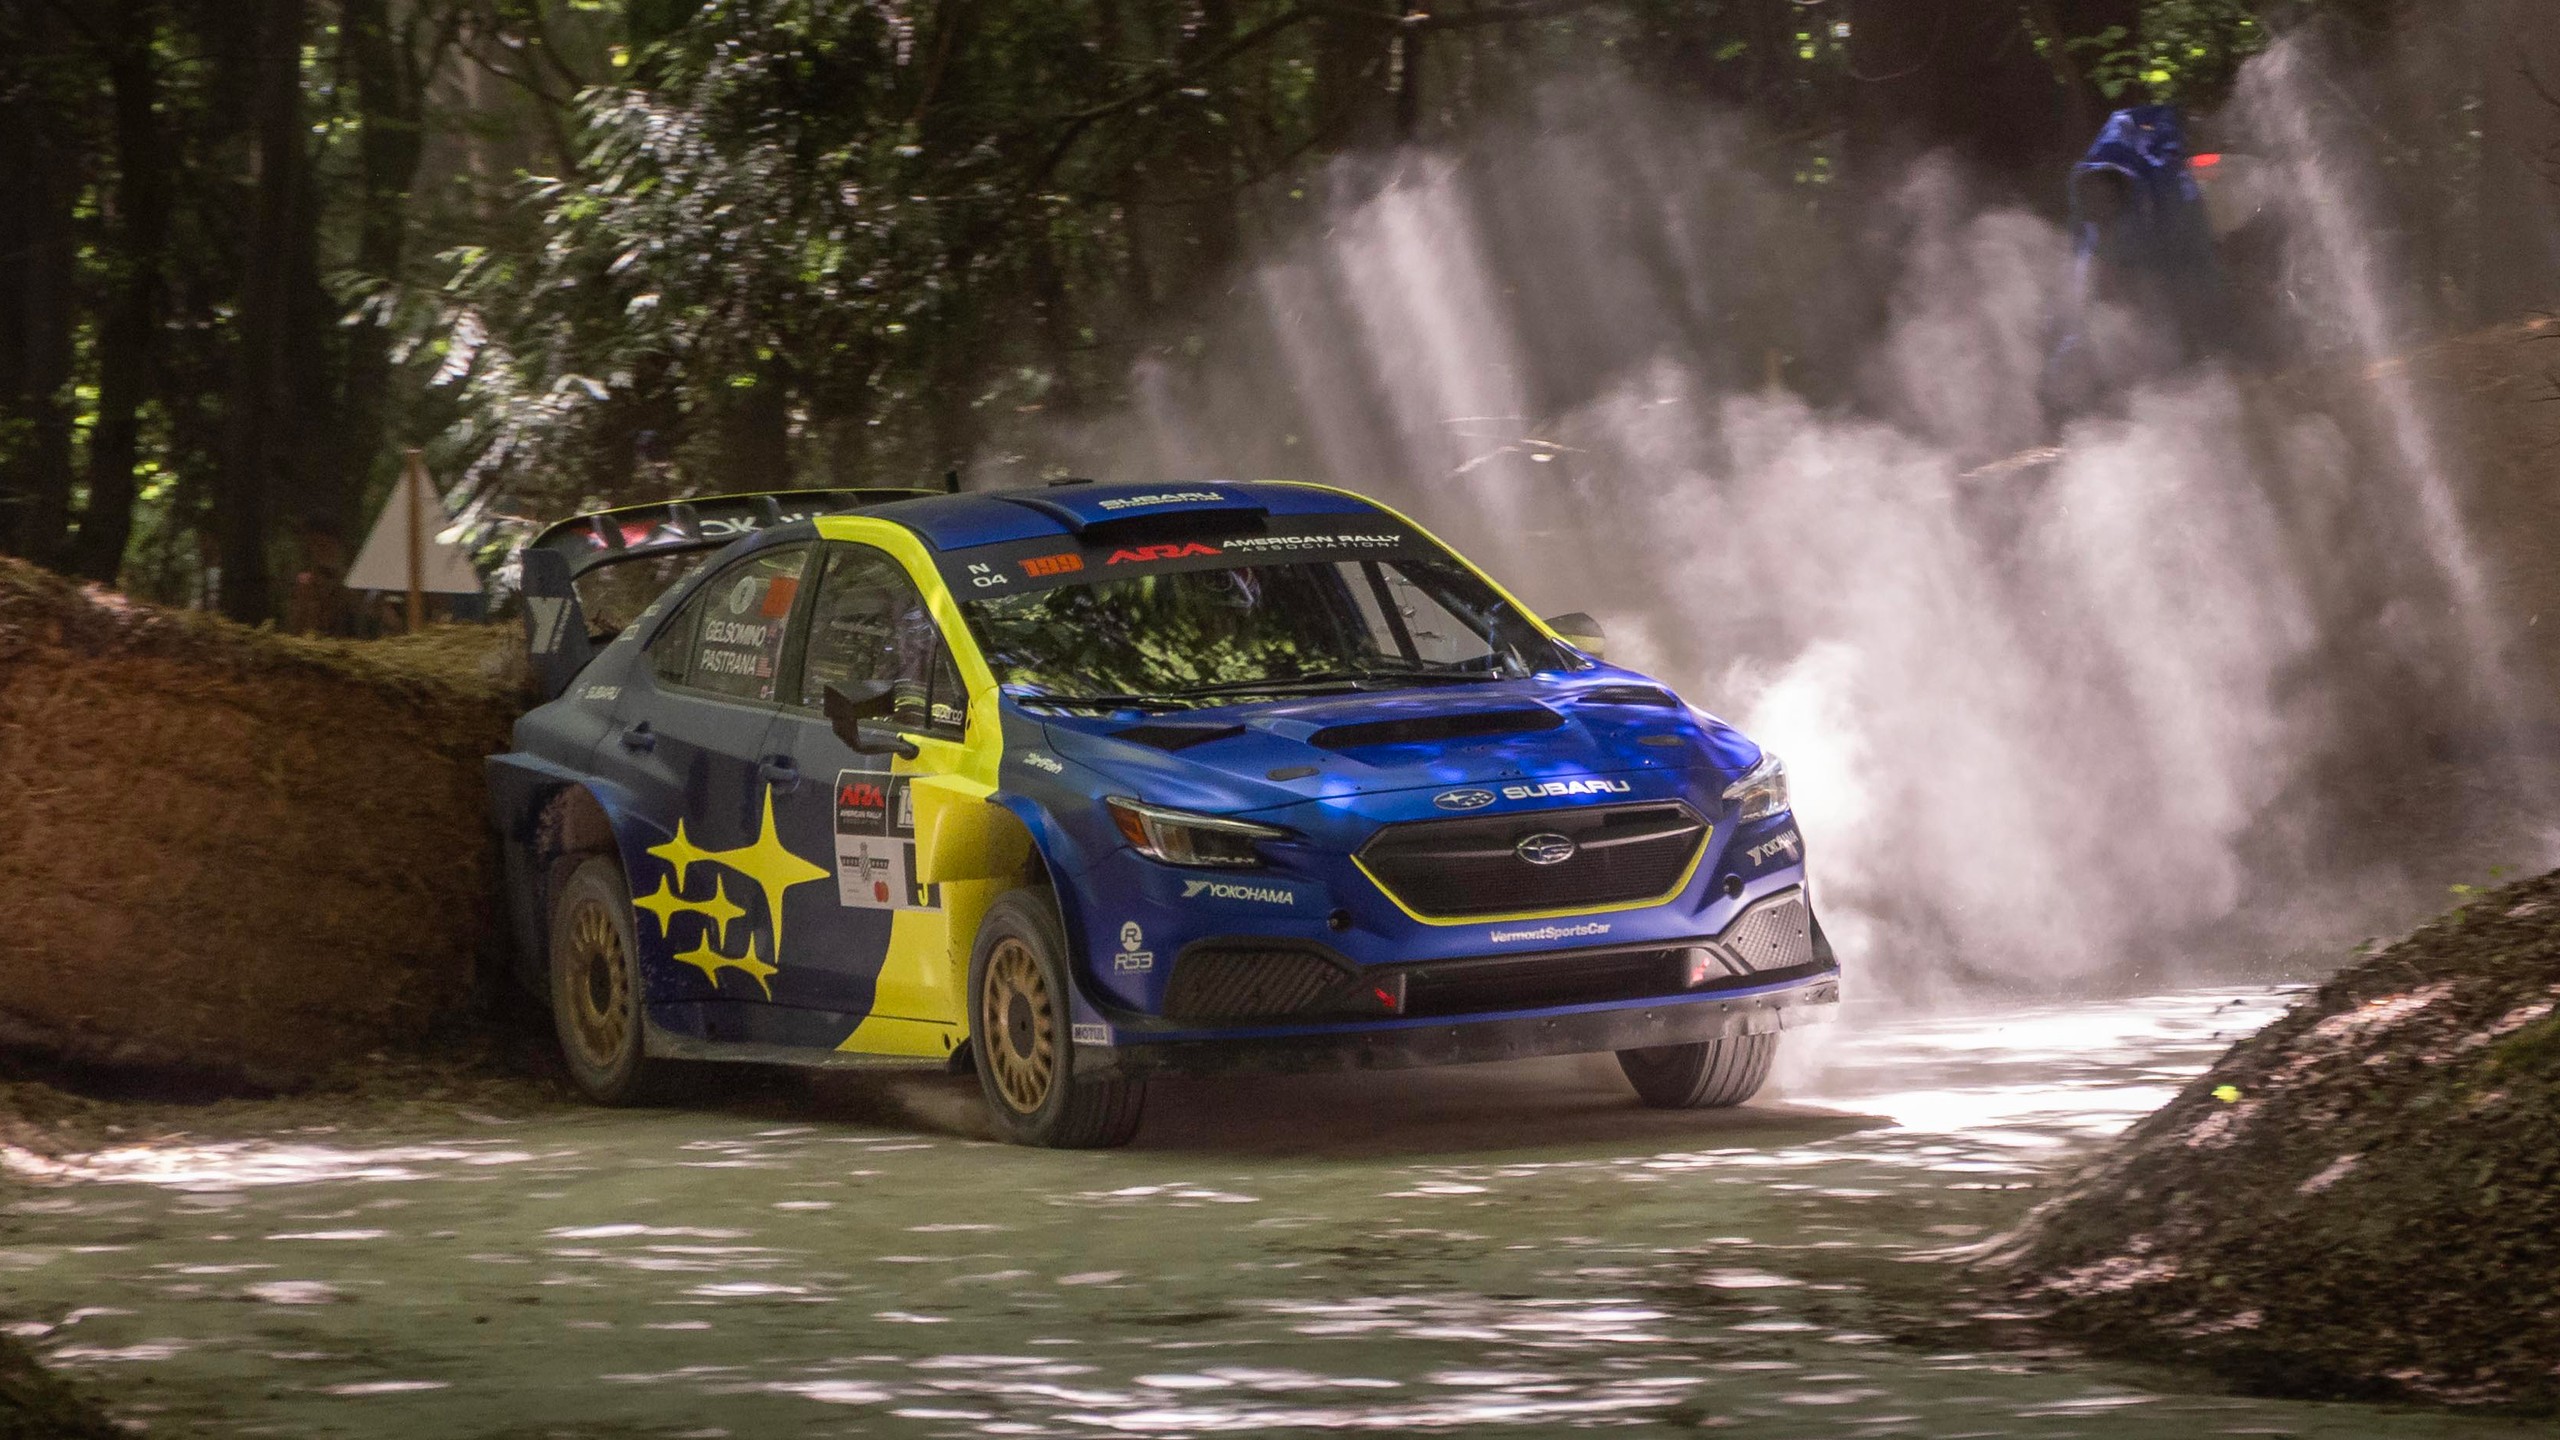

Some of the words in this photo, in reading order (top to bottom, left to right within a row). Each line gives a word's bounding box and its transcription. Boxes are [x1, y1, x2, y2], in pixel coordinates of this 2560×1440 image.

[1099, 491, 1222, 505] SUBARU
[1222, 535, 1334, 548] AMERICAN
[1105, 543, 1222, 565] ARA
[705, 620, 767, 647] GELSOMINO
[701, 648, 757, 675] PASTRANA
[1502, 779, 1631, 801] SUBARU
[1207, 882, 1294, 905] YOKOHAMA
[1490, 921, 1612, 944] VermontSportsCar
[1114, 951, 1154, 970] R53
